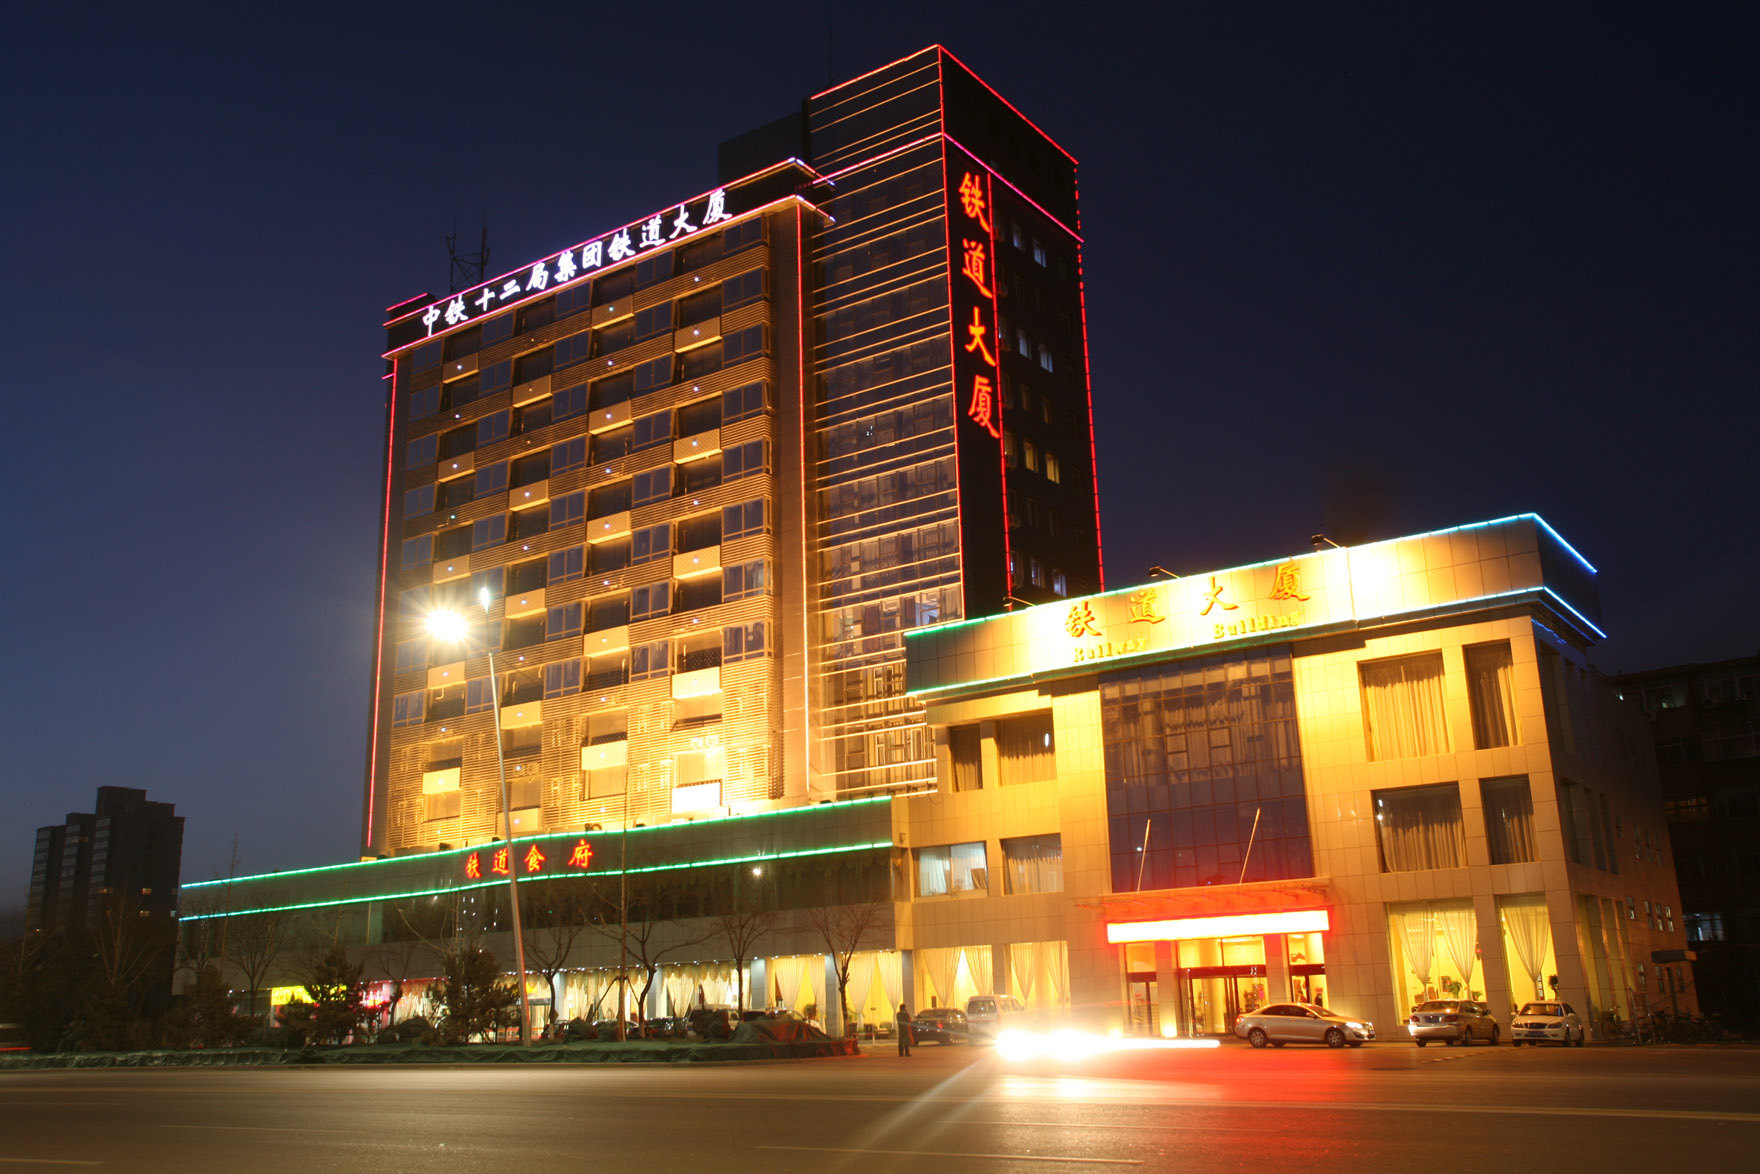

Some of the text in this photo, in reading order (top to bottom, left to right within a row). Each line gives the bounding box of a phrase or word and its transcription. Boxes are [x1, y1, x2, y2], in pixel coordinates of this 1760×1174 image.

[422, 188, 732, 337] 中铁十二局集团铁道大厦
[958, 171, 1000, 439] 铁道大厦
[1065, 561, 1311, 637] 铁道大厦
[1213, 611, 1305, 640] Building
[465, 838, 594, 879] 铁道食府
